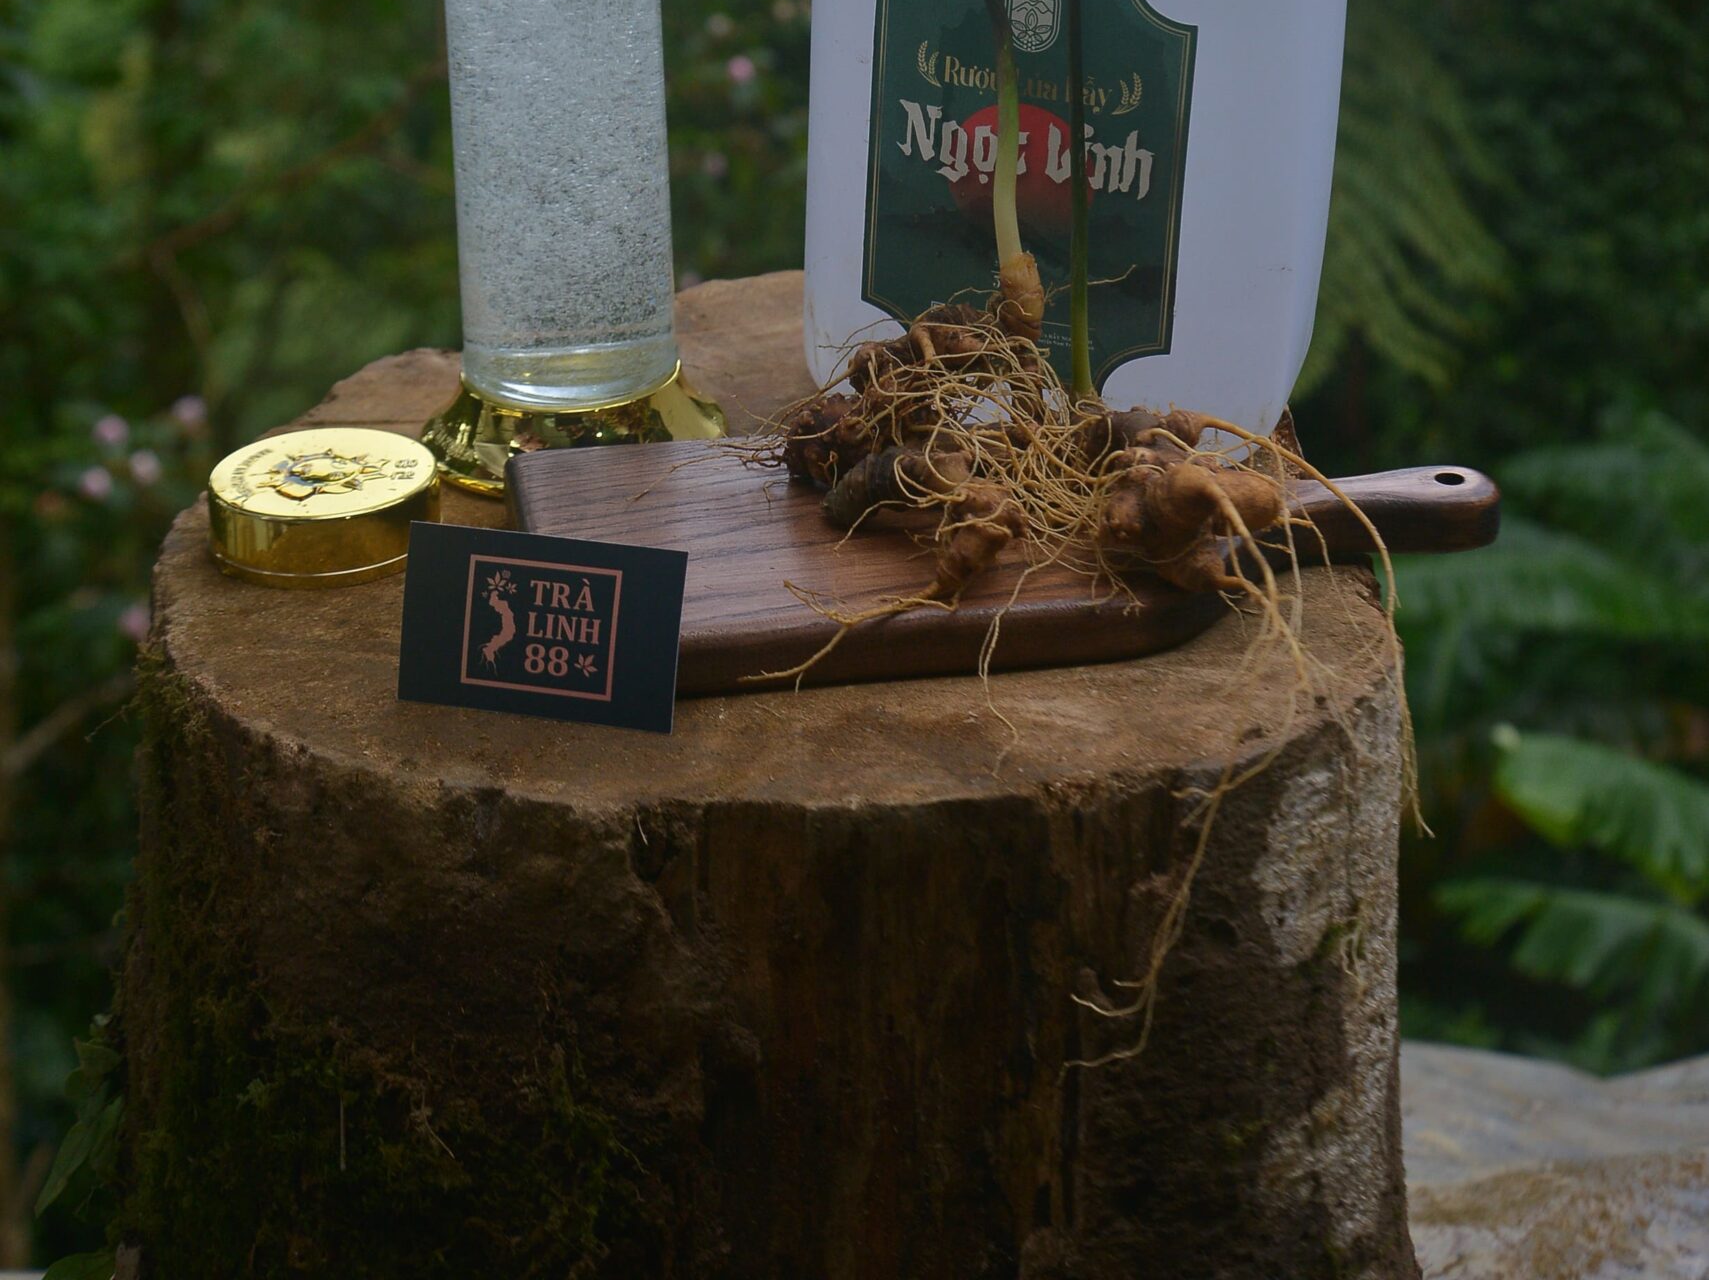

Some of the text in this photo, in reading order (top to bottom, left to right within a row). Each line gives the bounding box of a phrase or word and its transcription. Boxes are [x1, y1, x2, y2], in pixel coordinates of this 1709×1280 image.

[529, 578, 595, 612] TRÀ
[526, 611, 602, 645] LINH
[523, 643, 570, 677] 88
